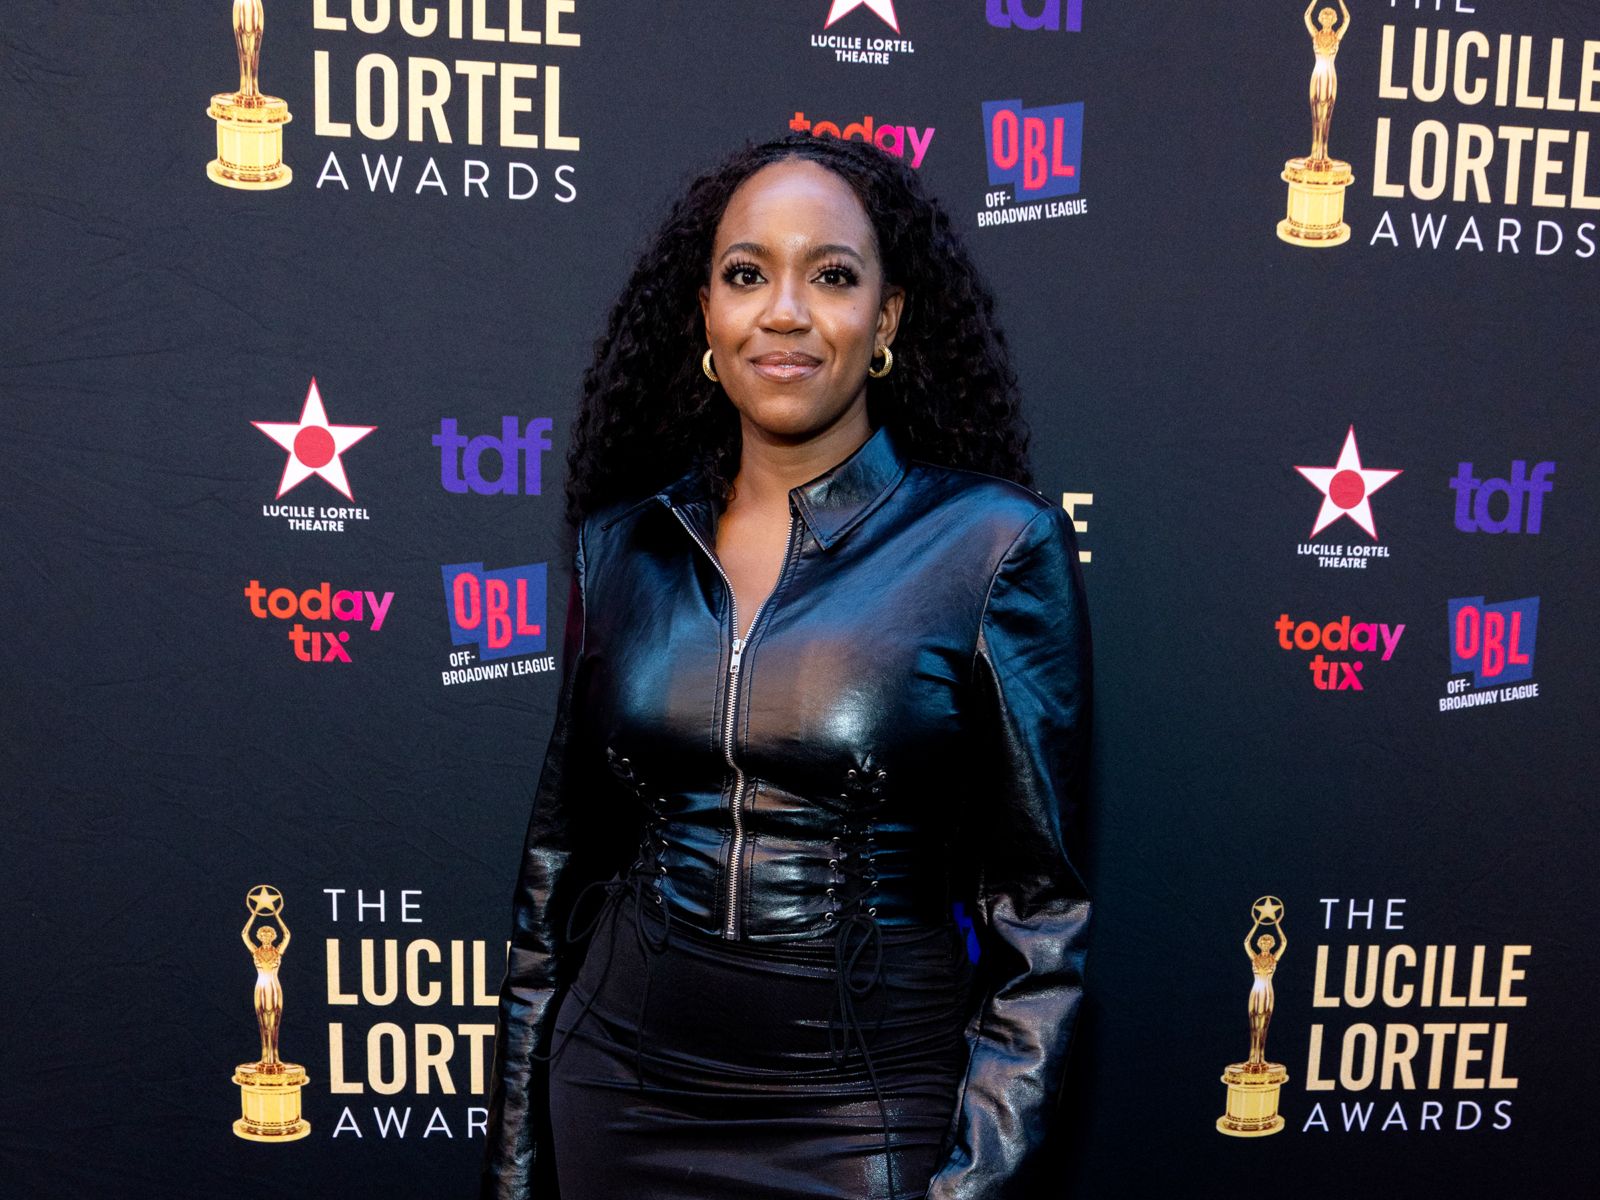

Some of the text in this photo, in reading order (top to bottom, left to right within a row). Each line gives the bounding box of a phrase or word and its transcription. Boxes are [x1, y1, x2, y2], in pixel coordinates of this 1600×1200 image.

[811, 34, 914, 53] LUCILLE LORTEL
[835, 50, 889, 65] THEATRE
[1378, 24, 1600, 113] LUCILLE
[313, 50, 581, 151] LORTEL
[991, 109, 1075, 190] OBL
[1372, 117, 1600, 210] LORTEL
[316, 151, 577, 203] AWARDS
[977, 199, 1088, 227] BROADWAY LEAGUE
[985, 191, 1011, 208] OFF-
[1370, 210, 1596, 258] AWARDS
[431, 415, 553, 496] tdf
[262, 505, 370, 520] LUCILLE LORTEL
[1449, 460, 1556, 535] tdf
[288, 519, 344, 532] THEATRE
[1297, 544, 1390, 558] LUCILLE LORTEL
[1318, 556, 1367, 568] THEATRE
[244, 580, 395, 631] today
[452, 572, 541, 649] OBL
[288, 623, 352, 663] tix
[1275, 614, 1406, 661] today
[1455, 605, 1530, 677] OBL
[442, 656, 556, 686] BROADWAY LEAGUE
[449, 651, 476, 668] OFF-
[1309, 654, 1364, 691] tix
[1439, 683, 1540, 712] BROADWAY LEAGUE
[1447, 679, 1471, 695] OFF-
[323, 888, 423, 923] THE
[1319, 898, 1406, 930] THE
[326, 938, 511, 1007] LUCIL
[1312, 944, 1532, 1008] LUCILLE
[328, 1022, 496, 1095] LORT
[1305, 1022, 1519, 1091] LORTEL
[332, 1106, 489, 1139] AWAR
[1302, 1100, 1513, 1133] AWARDS
